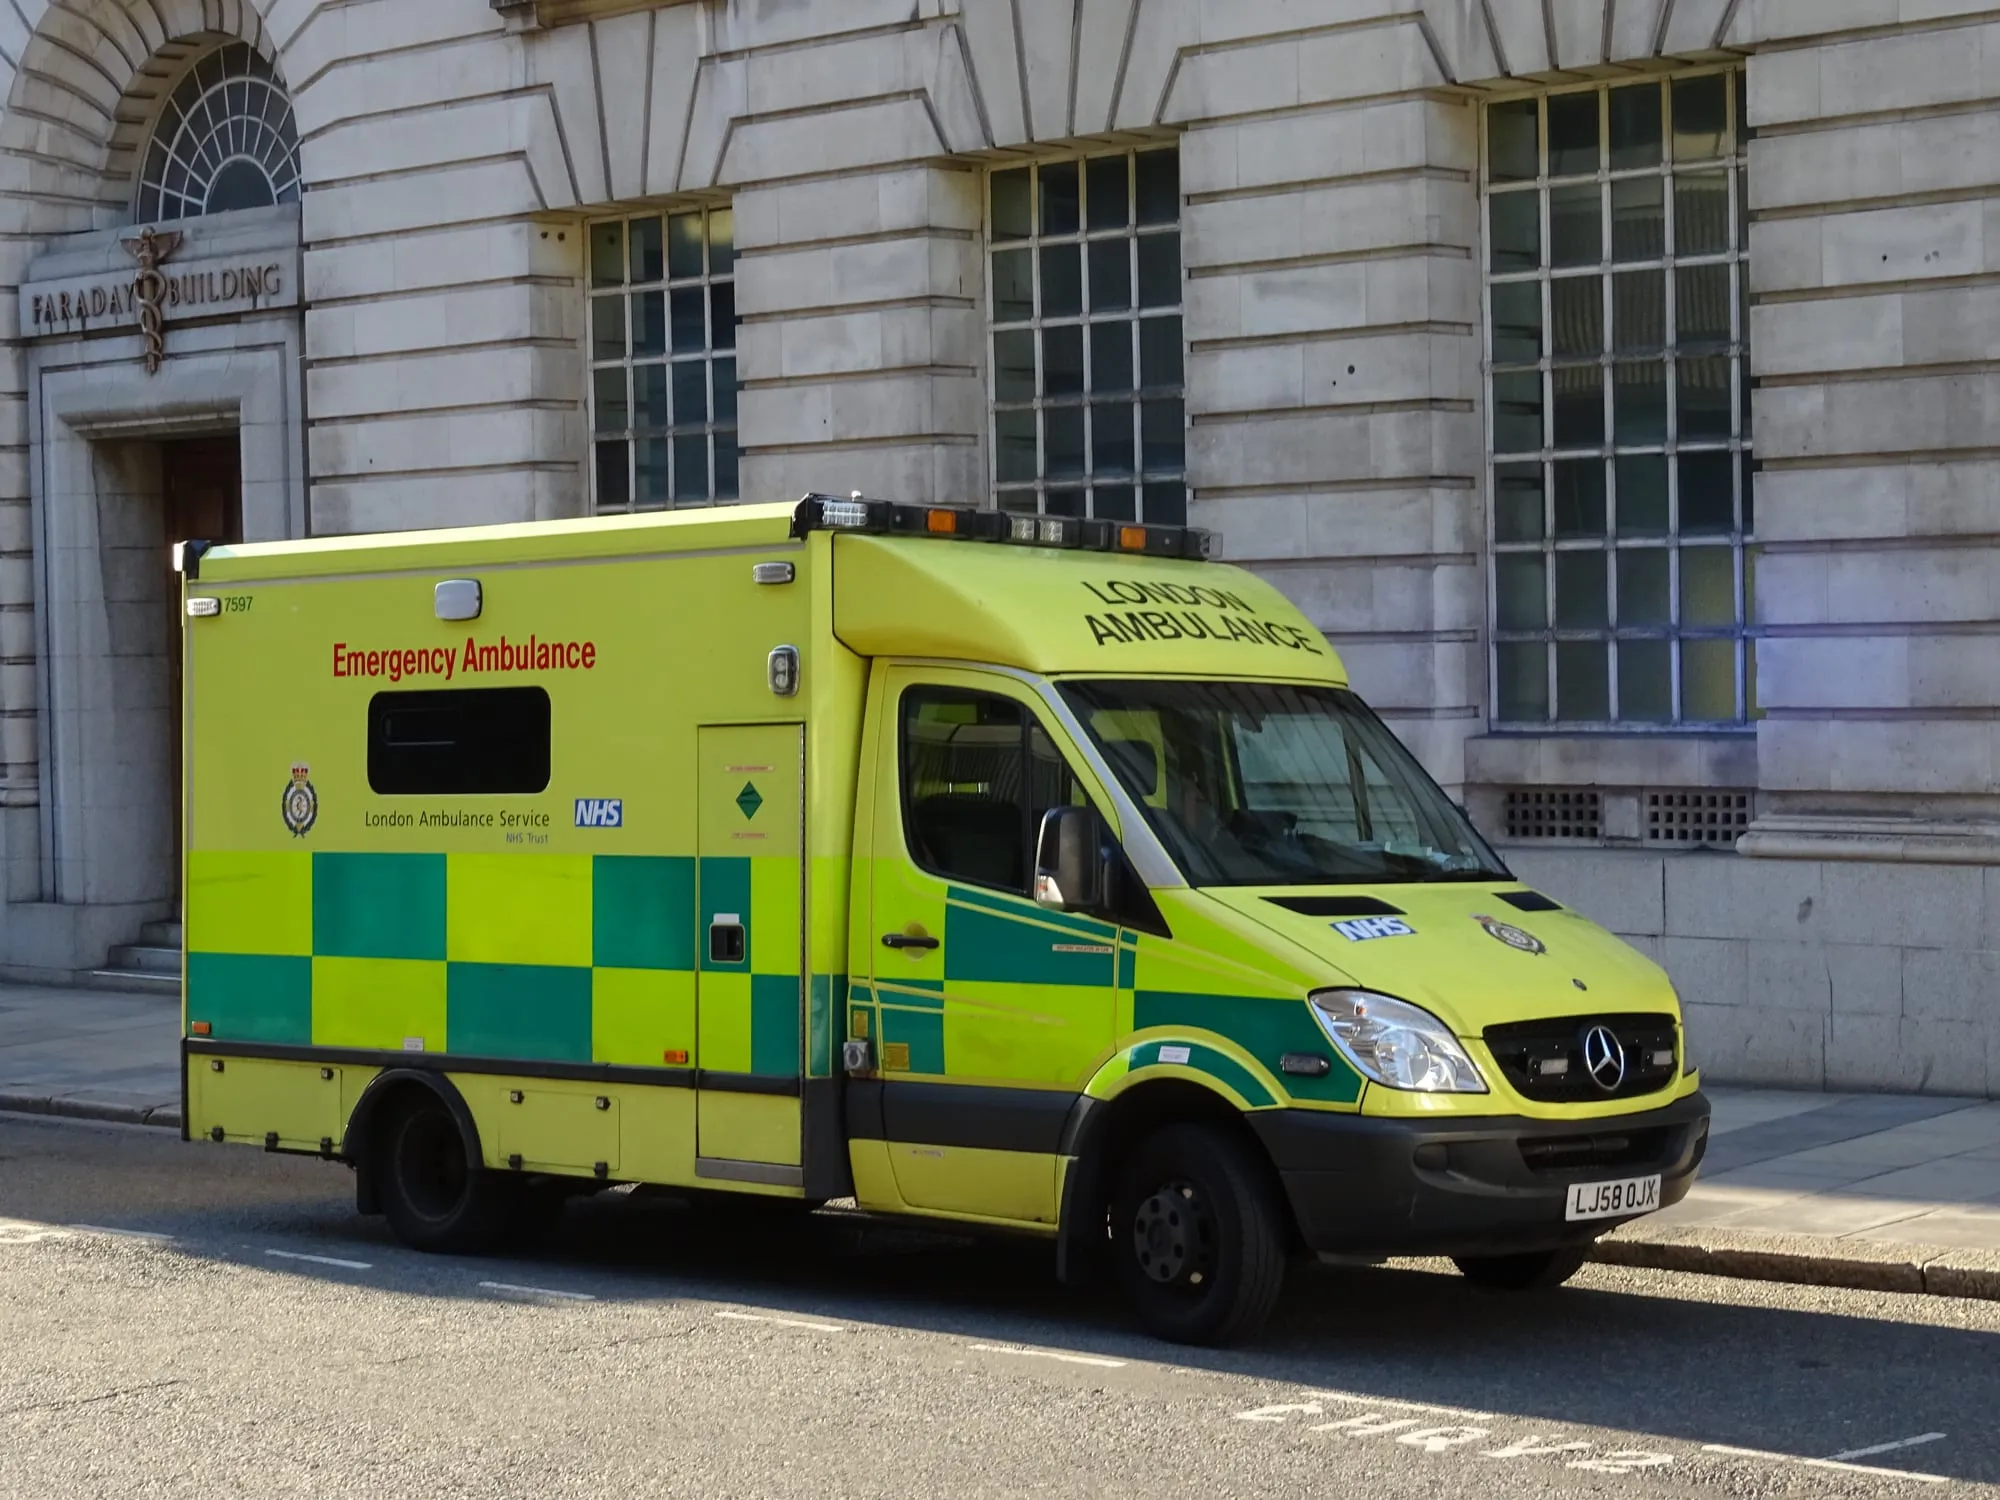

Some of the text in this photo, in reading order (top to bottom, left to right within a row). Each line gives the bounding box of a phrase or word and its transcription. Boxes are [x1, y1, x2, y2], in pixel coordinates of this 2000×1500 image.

[33, 264, 281, 325] FARADAY BUILDING
[224, 596, 253, 612] 7597
[1081, 580, 1256, 614] LONDON
[1084, 611, 1324, 656] AMBULANCE
[333, 634, 596, 682] Emergency Ambulance
[365, 809, 550, 827] London Ambulance Service
[575, 799, 620, 826] NHS
[506, 832, 549, 844] NHS Trust
[1336, 916, 1412, 942] NHS
[1575, 1186, 1622, 1214] LJ58
